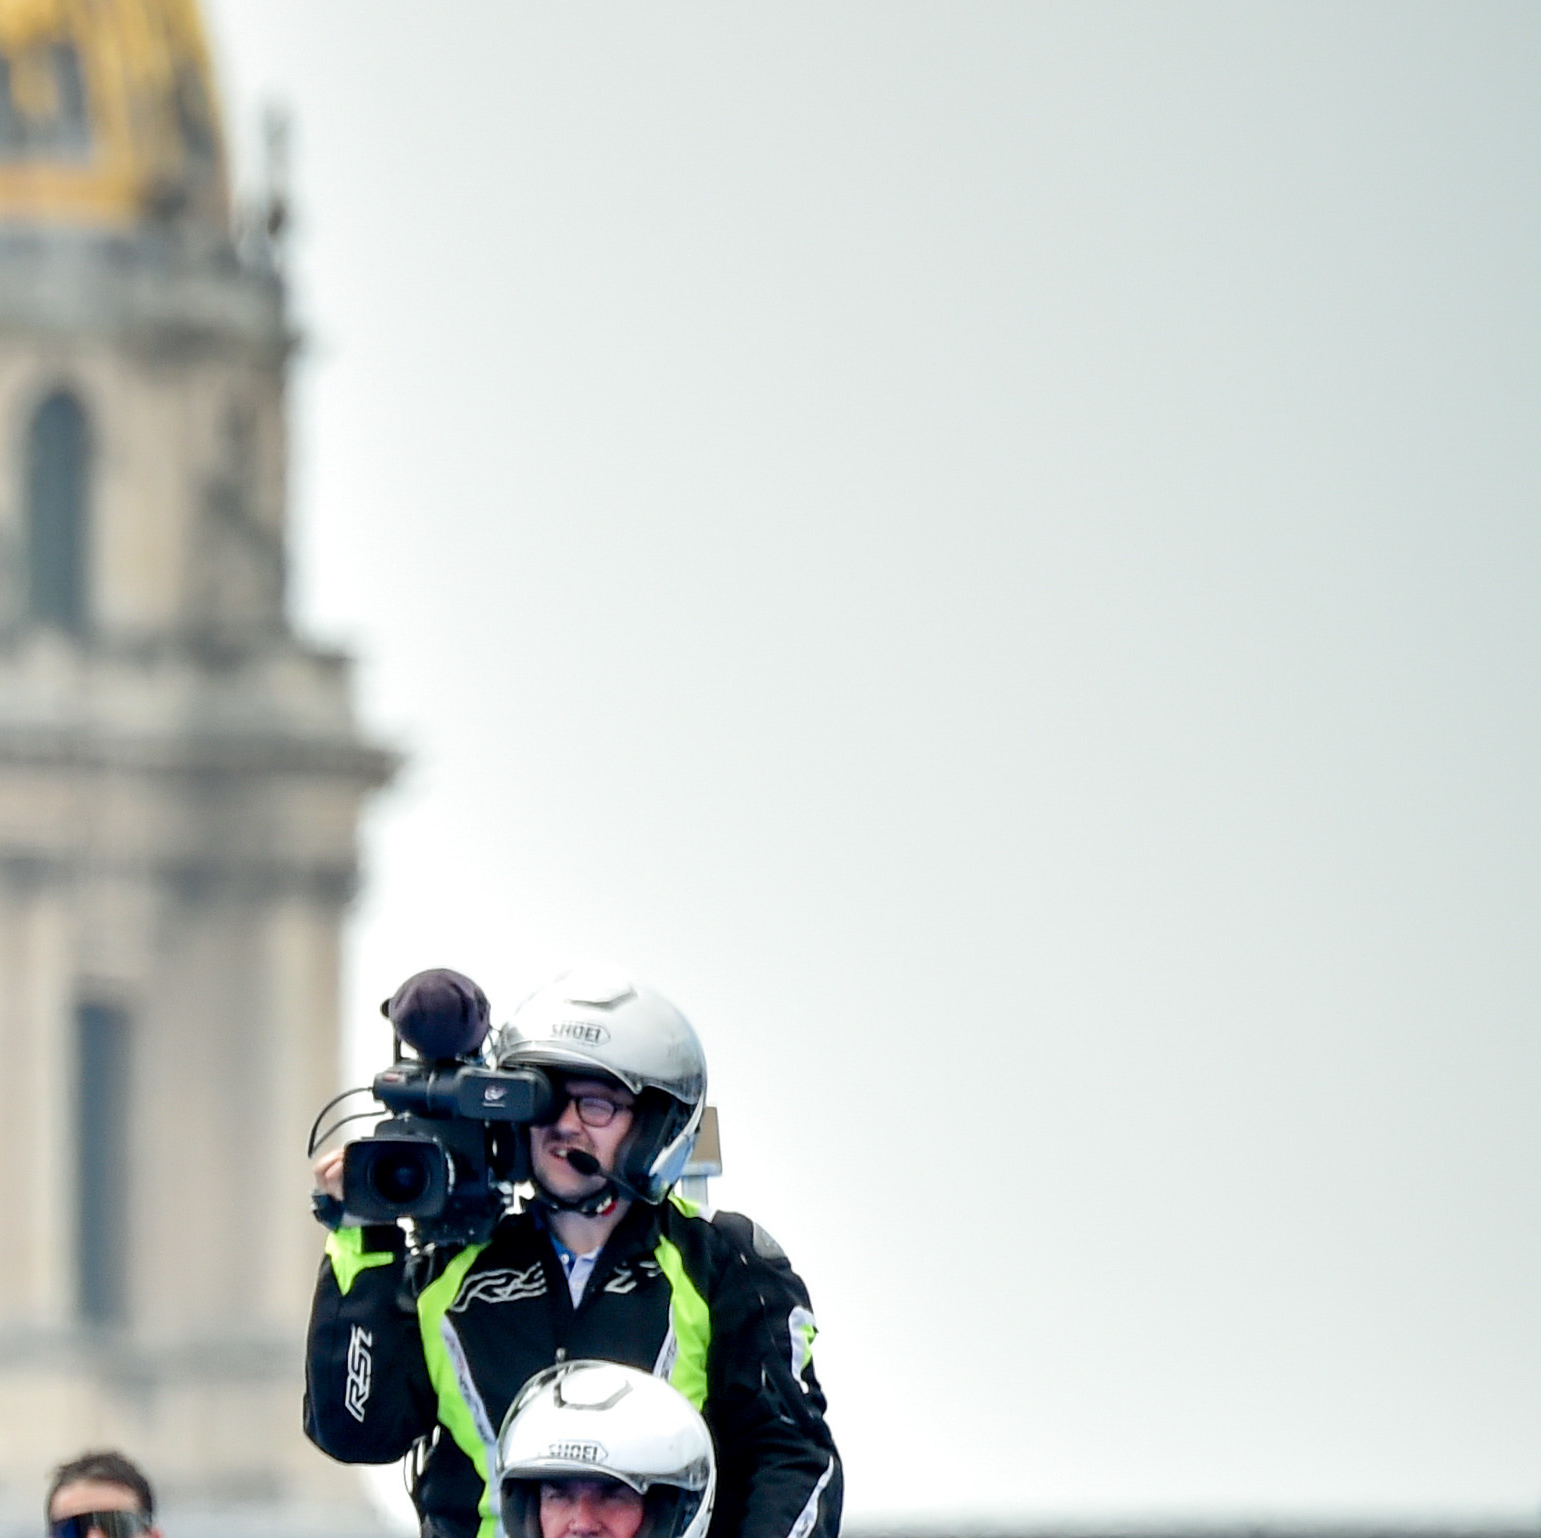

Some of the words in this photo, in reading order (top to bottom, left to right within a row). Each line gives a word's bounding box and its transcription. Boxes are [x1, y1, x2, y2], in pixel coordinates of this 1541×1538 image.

[550, 1023, 601, 1043] SHOEI
[345, 1323, 372, 1423] RST
[548, 1443, 598, 1461] SHOEI
